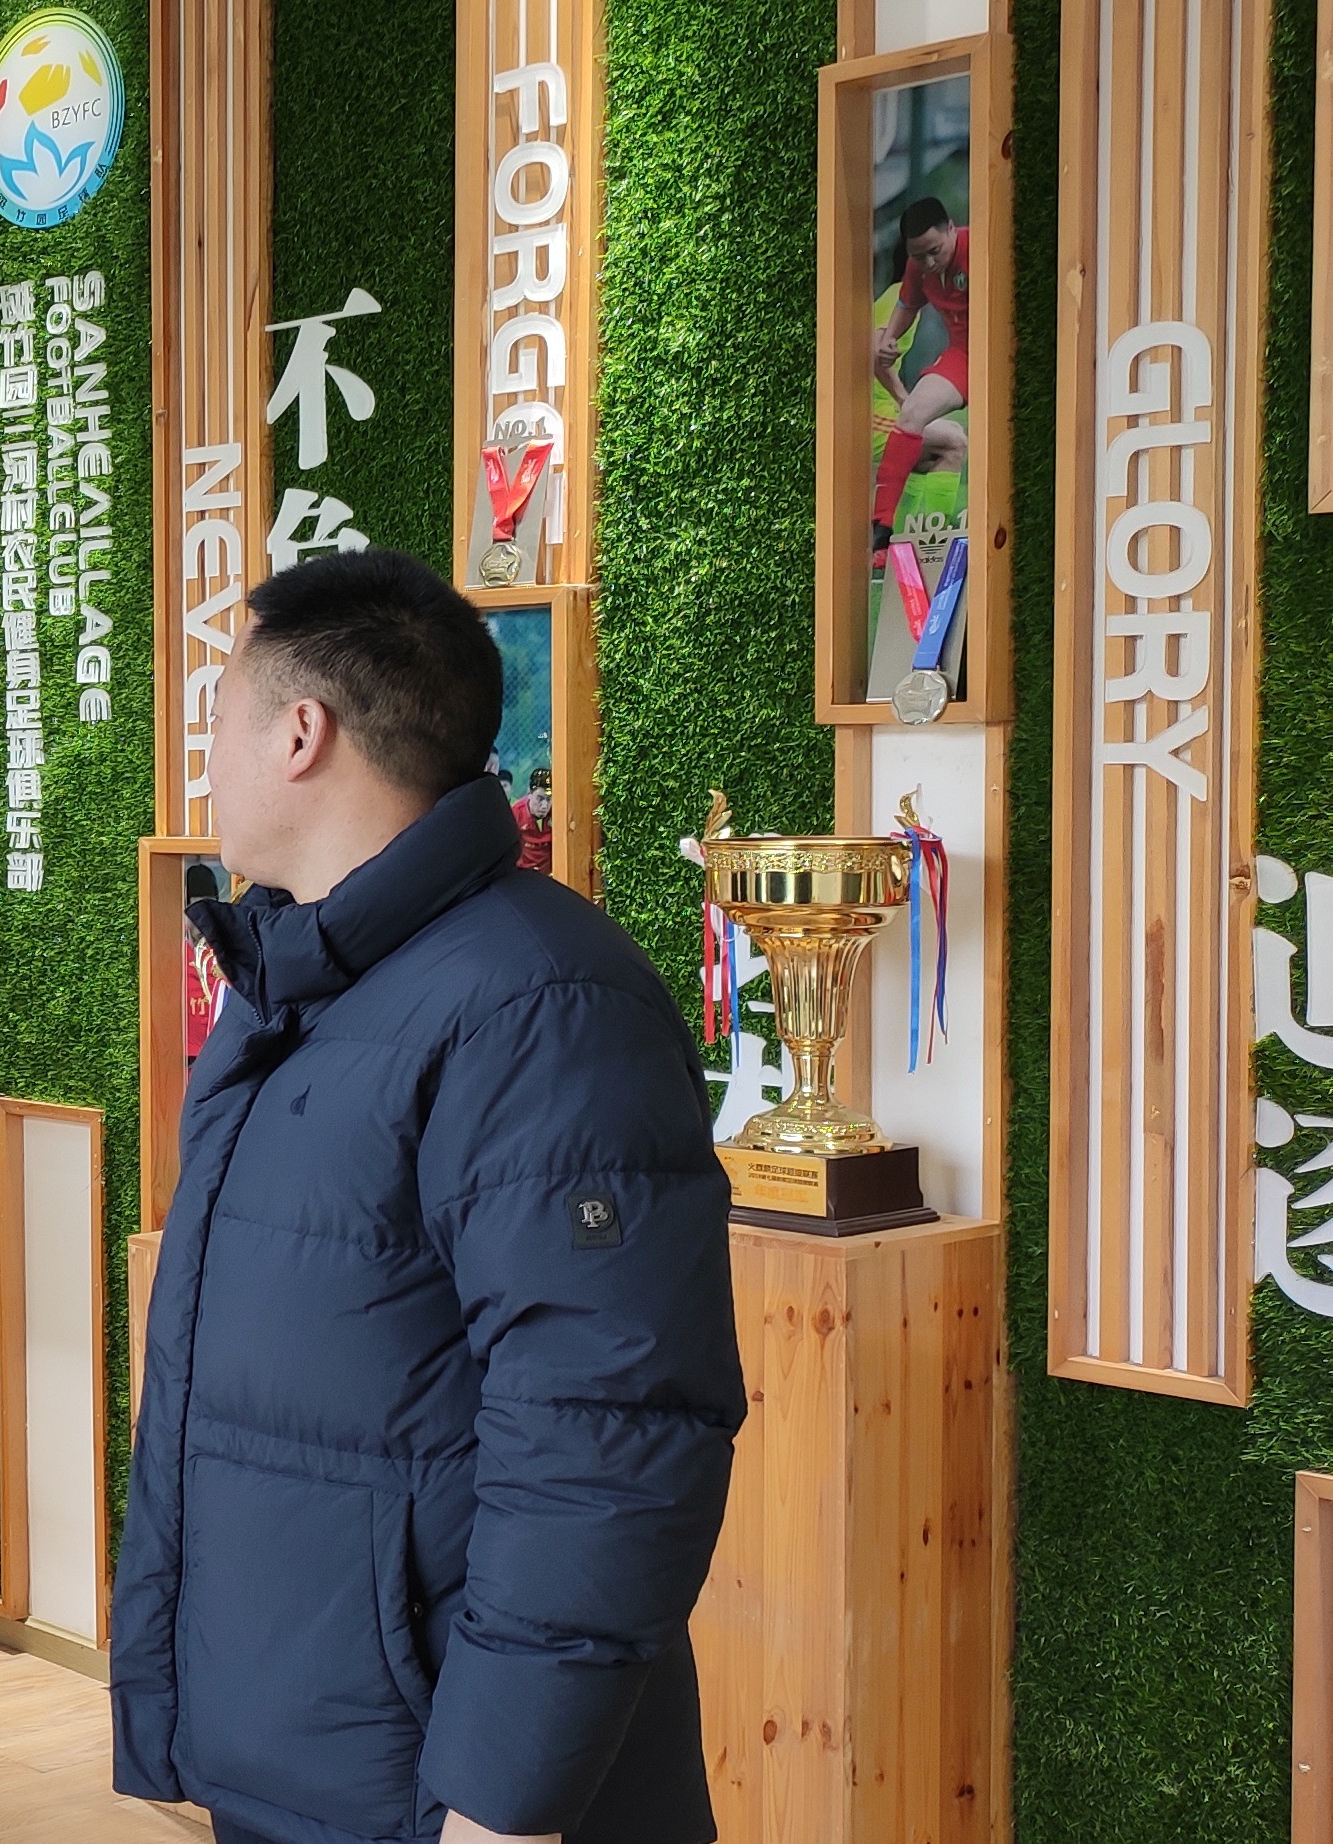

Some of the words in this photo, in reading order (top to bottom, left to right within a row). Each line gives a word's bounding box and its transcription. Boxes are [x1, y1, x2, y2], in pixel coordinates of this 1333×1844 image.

[51, 98, 102, 130] BZYFC
[45, 275, 76, 504] FOOTBALL
[73, 270, 113, 478] SANHE
[48, 503, 77, 616] CLUB
[77, 482, 114, 722] VILLAGE
[1101, 321, 1215, 804] GLORY
